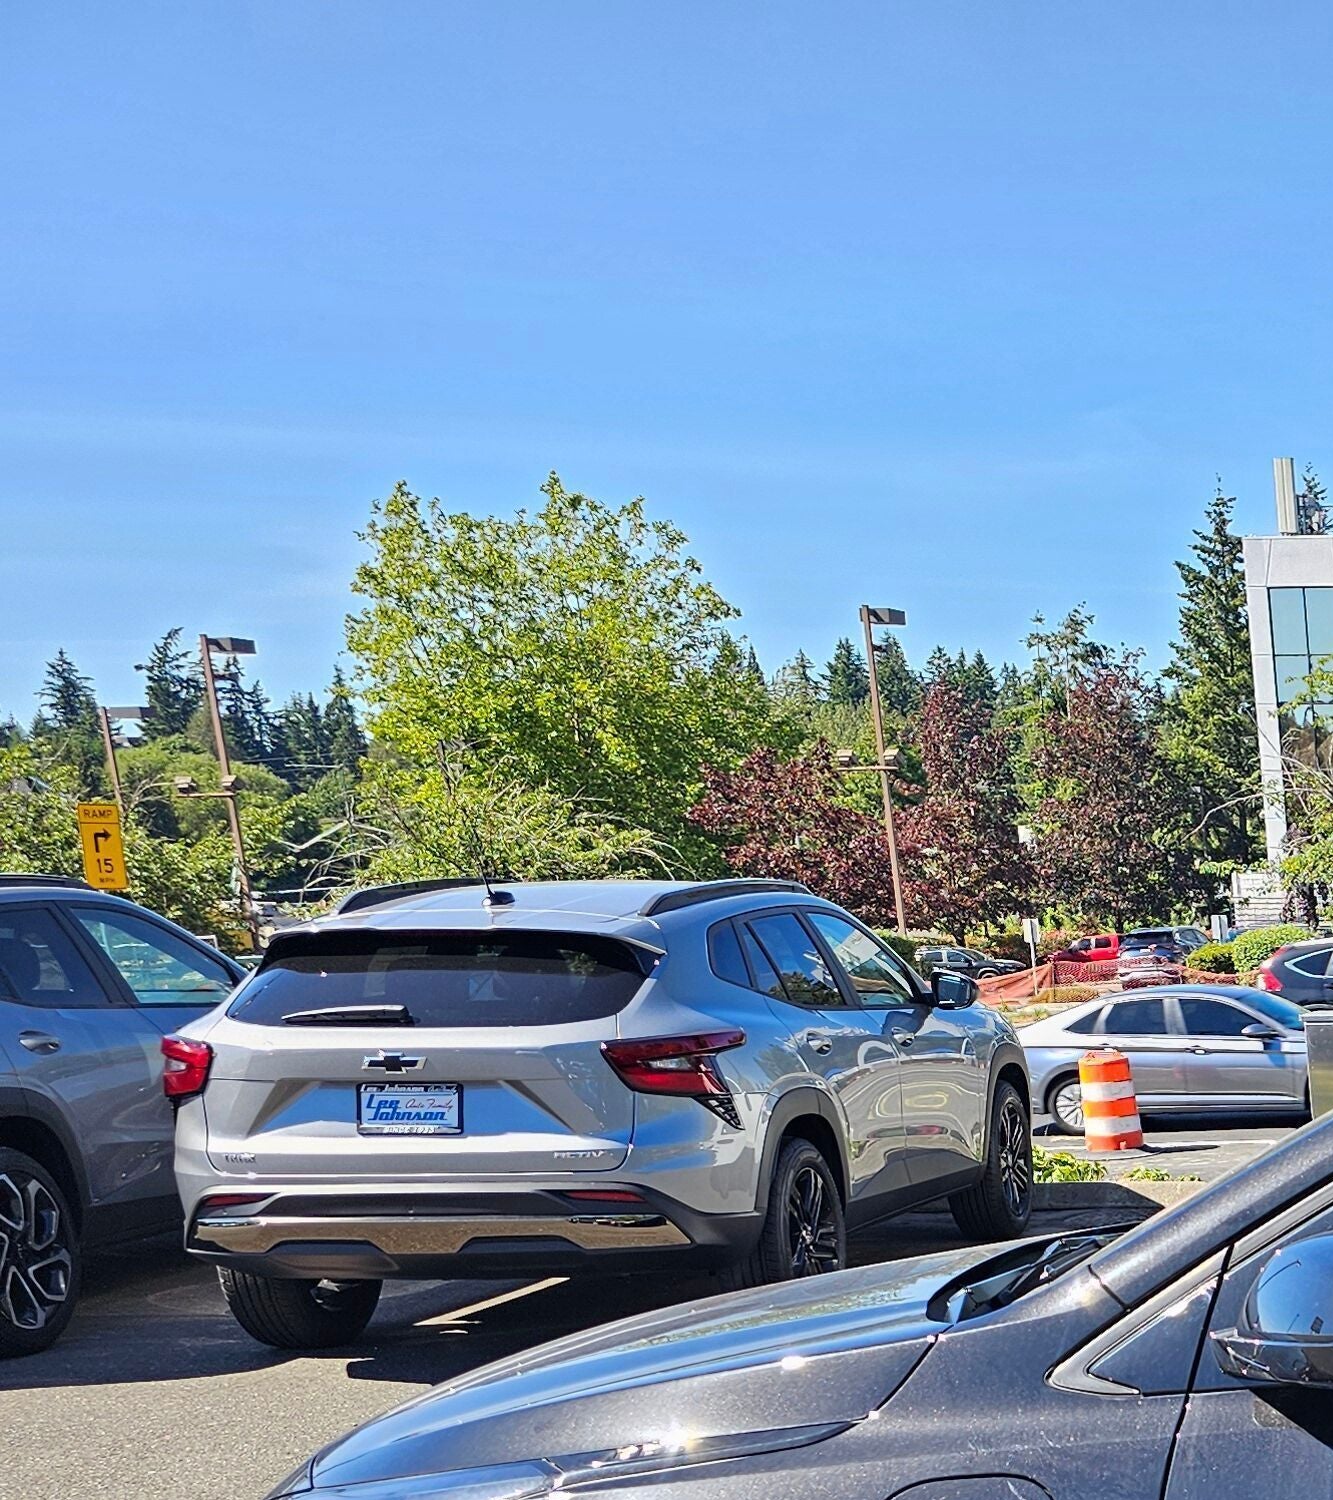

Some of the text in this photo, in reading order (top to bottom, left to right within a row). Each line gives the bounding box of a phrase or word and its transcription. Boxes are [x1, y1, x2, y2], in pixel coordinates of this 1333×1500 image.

[83, 809, 113, 818] RAMP
[96, 858, 114, 874] 15
[382, 1083, 425, 1092] Johnson
[366, 1094, 401, 1109] Lee
[368, 1107, 448, 1121] Johnson
[553, 1150, 606, 1159] ACTIV
